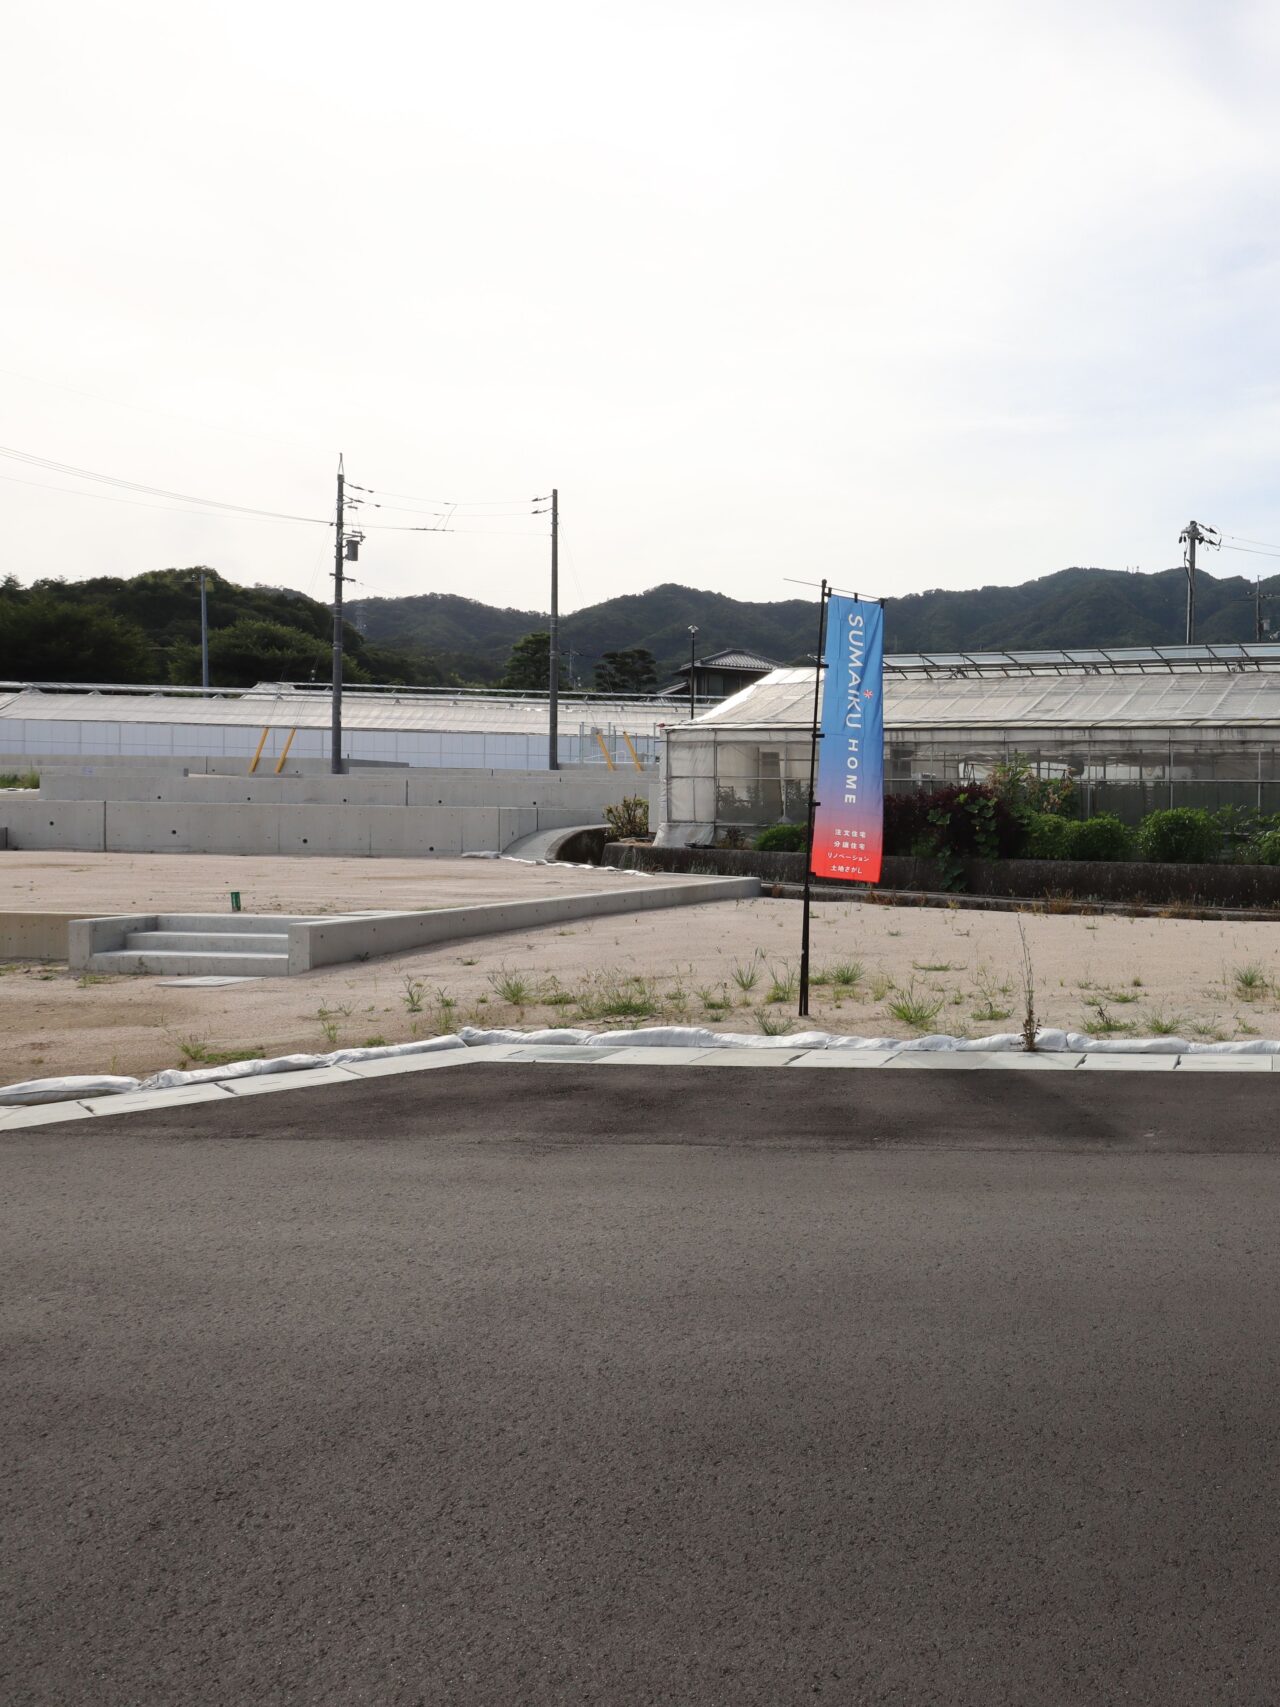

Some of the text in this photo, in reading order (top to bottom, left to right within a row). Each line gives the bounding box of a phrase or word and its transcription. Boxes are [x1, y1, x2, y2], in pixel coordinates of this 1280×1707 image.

[844, 614, 864, 804] SUMAIKU HOME
[834, 828, 867, 839] 注文住宅
[827, 851, 870, 862] リノベーション
[831, 864, 863, 874] 土地さがし
